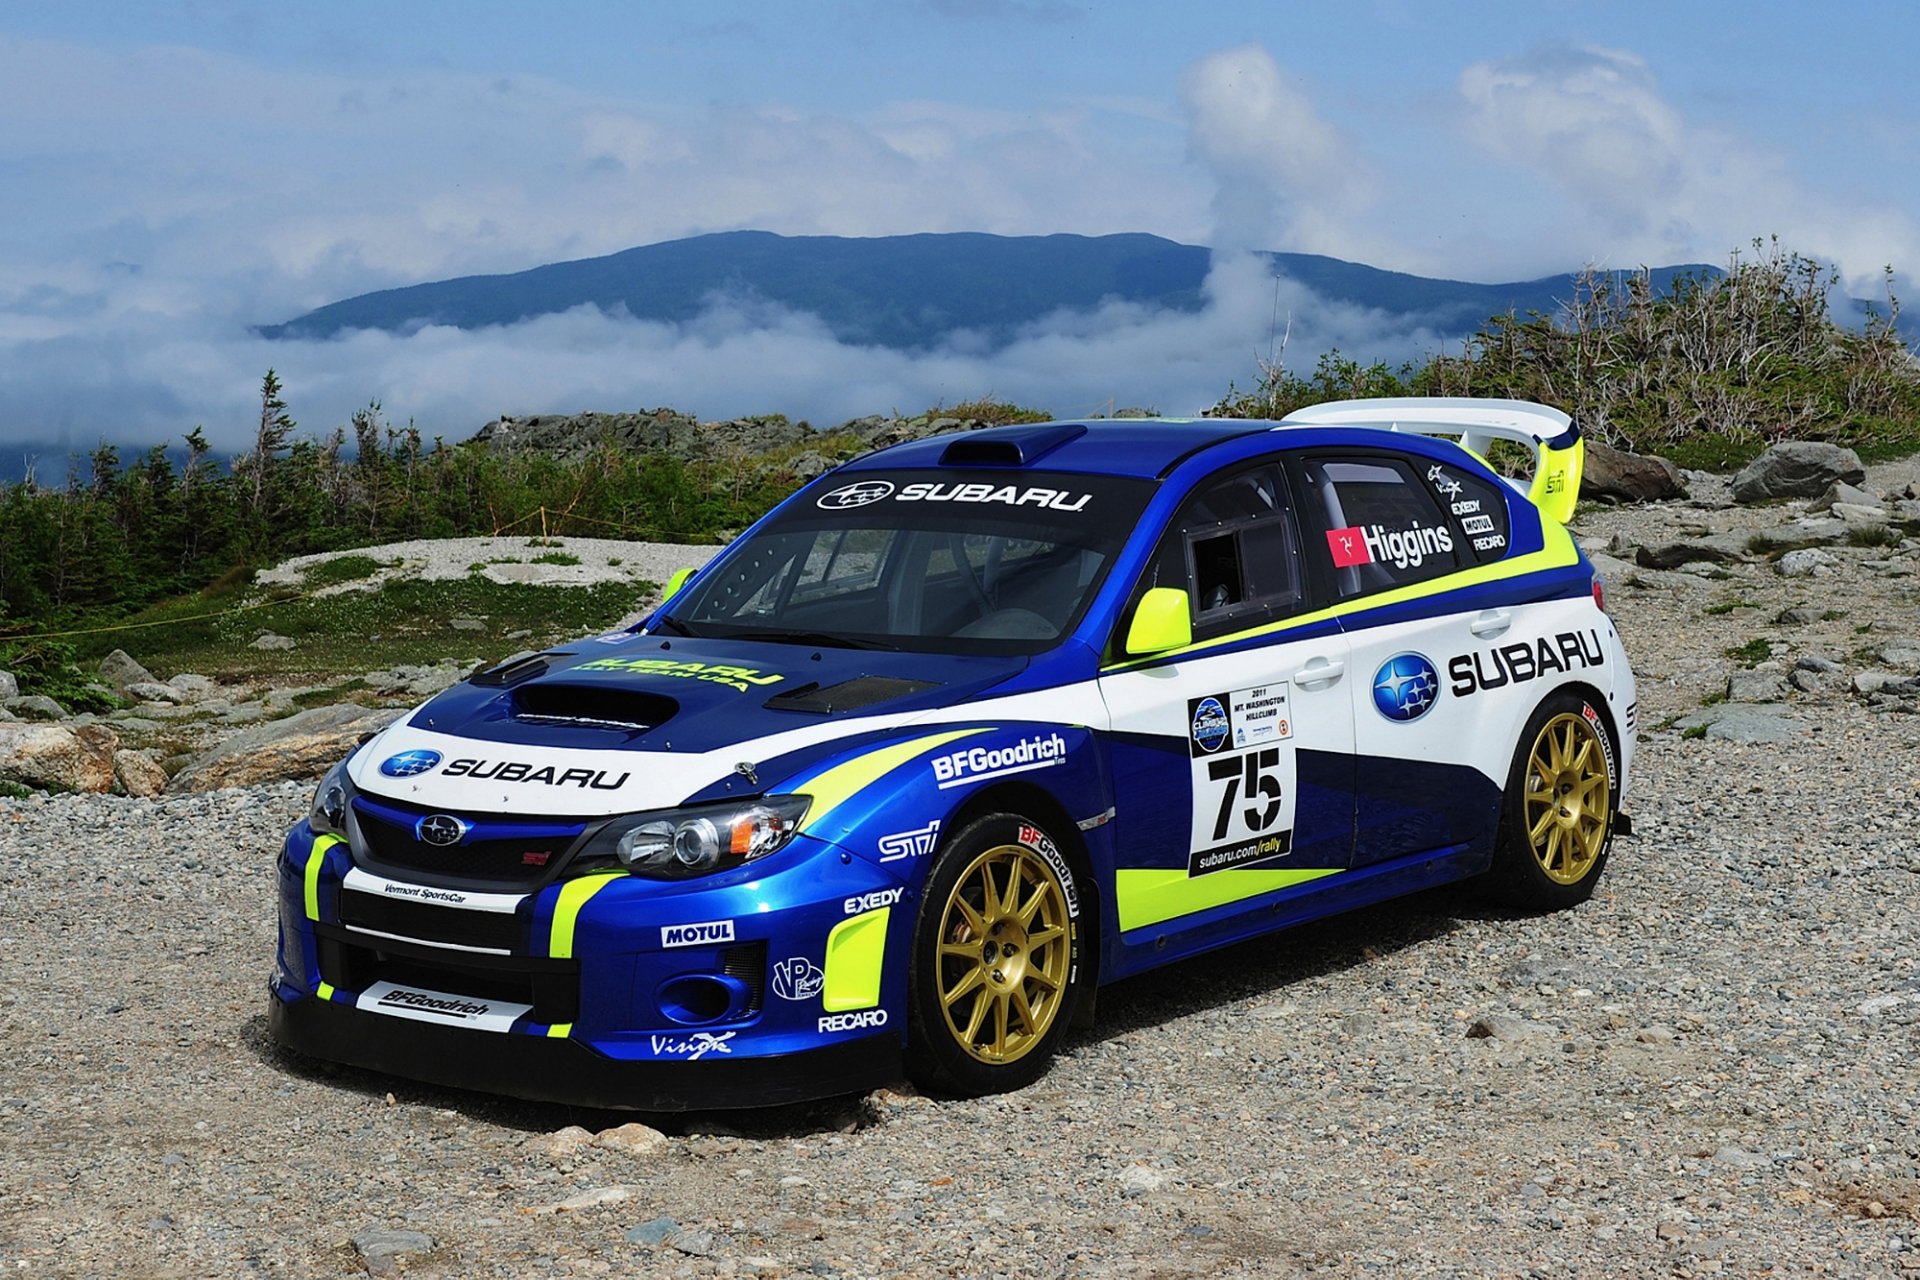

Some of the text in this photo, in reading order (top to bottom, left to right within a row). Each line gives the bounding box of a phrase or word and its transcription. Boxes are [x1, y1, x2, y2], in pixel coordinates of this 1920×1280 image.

[895, 483, 1093, 511] SUBARU
[1451, 500, 1481, 516] EXEDY
[1465, 518, 1491, 532] MOTUL
[1360, 520, 1453, 569] Higgins
[1473, 535, 1505, 552] RECARO
[1448, 629, 1604, 697] SUBARU
[697, 674, 749, 693] USA
[1252, 688, 1267, 698] 2011
[1234, 696, 1285, 712] MT. WASHINGTON
[1246, 709, 1277, 721] HILLCLIMB
[931, 733, 1066, 781] BFGoodrich
[441, 759, 631, 790] SUBARU
[1208, 748, 1281, 840] 75
[1200, 837, 1281, 868] subaru.com/rally
[1020, 825, 1080, 916] BFGoodrich
[385, 884, 466, 903] Vermont SportsCar
[844, 887, 904, 914] EXEDY
[666, 924, 731, 944] MOTUL
[773, 957, 811, 999] VP
[382, 990, 489, 1015] BFGoodrich
[818, 1009, 888, 1033] RECARO
